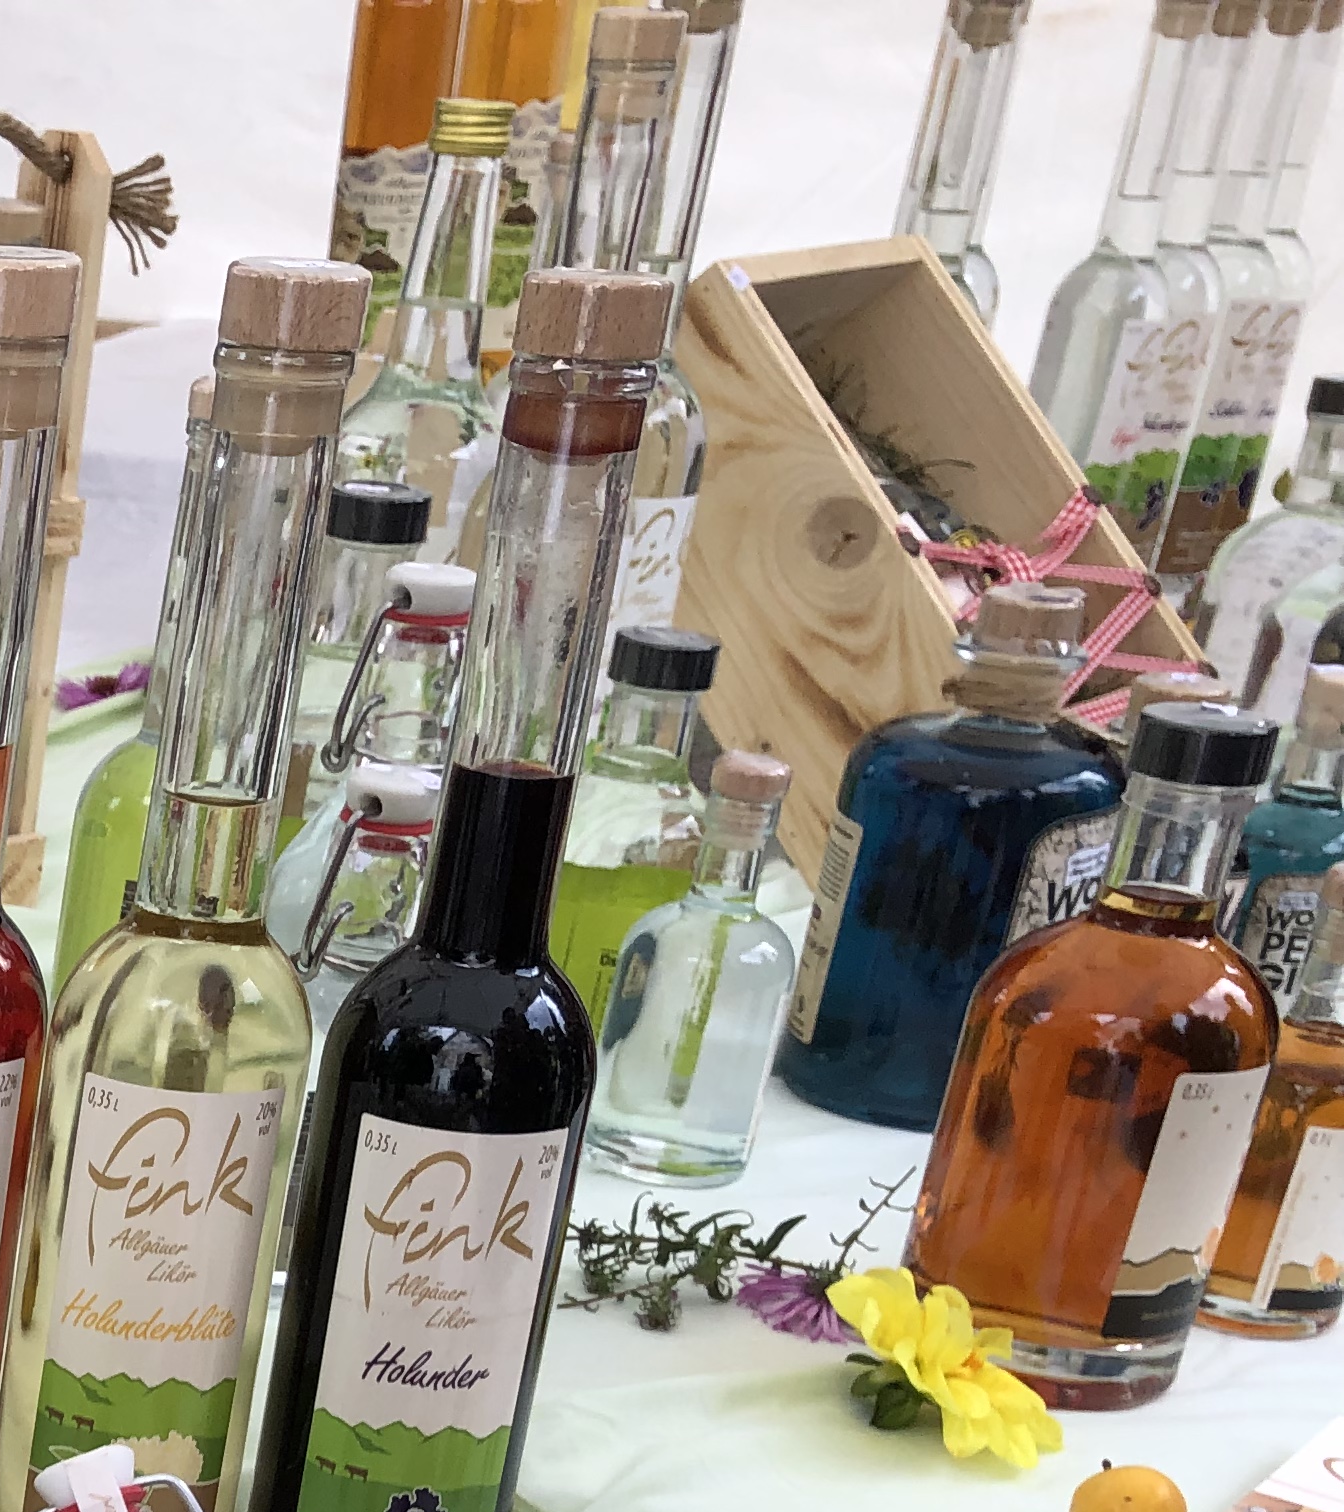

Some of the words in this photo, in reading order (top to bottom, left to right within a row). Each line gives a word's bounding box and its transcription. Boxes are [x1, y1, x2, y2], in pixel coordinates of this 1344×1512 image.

[88, 1086, 112, 1110] 0,35
[255, 1101, 278, 1121] 20%
[364, 1128, 390, 1153] 0,35
[88, 1107, 253, 1267] fink
[109, 1227, 189, 1261] Allgäuer
[364, 1150, 534, 1315] fink
[146, 1260, 198, 1284] Likör
[385, 1275, 468, 1306] Allgäuer
[61, 1288, 238, 1342] Holunderblüte
[425, 1306, 478, 1330] Likör
[361, 1342, 491, 1390] Holunder
